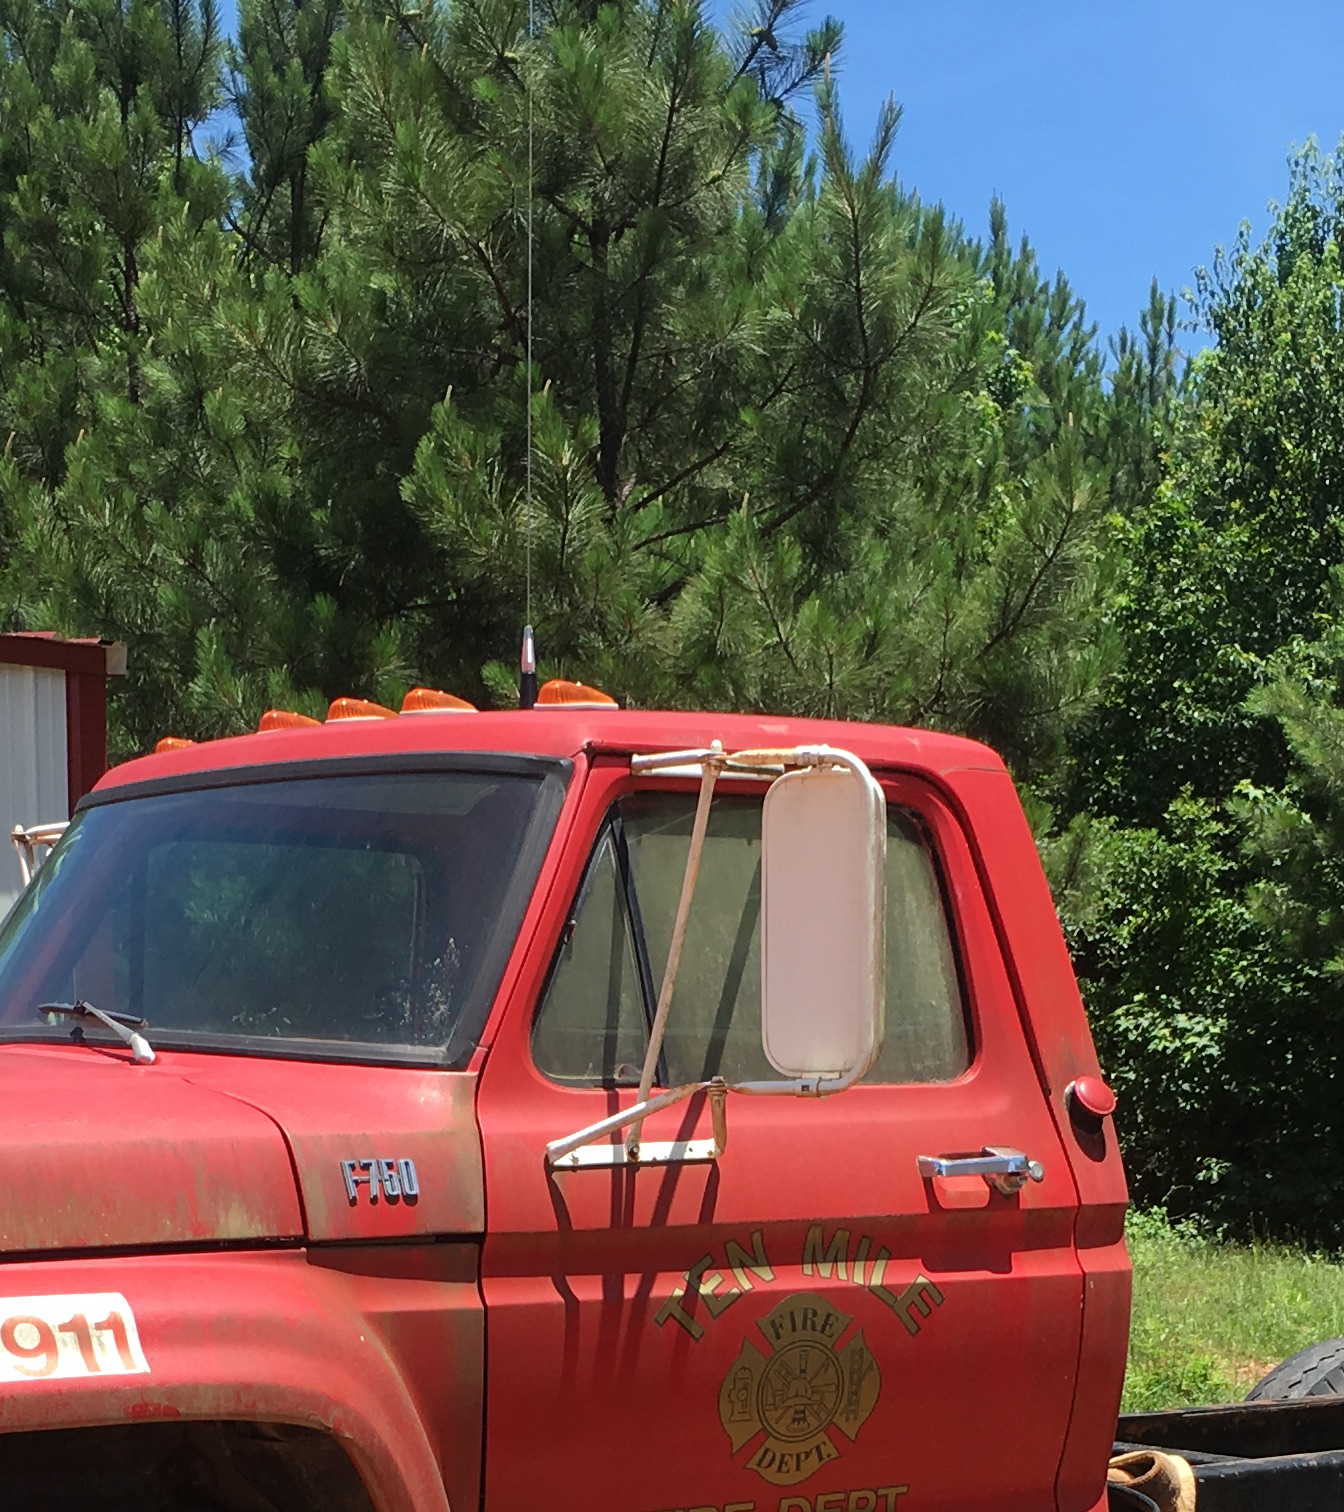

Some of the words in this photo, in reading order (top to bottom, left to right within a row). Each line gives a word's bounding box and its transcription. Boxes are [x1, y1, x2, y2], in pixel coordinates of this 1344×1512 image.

[340, 1158, 420, 1201] F750
[653, 1228, 778, 1343] TEN
[801, 1224, 946, 1337] MILE
[0, 1310, 138, 1377] 911
[769, 1307, 839, 1342] FIRE
[756, 1440, 833, 1474] DEPT.
